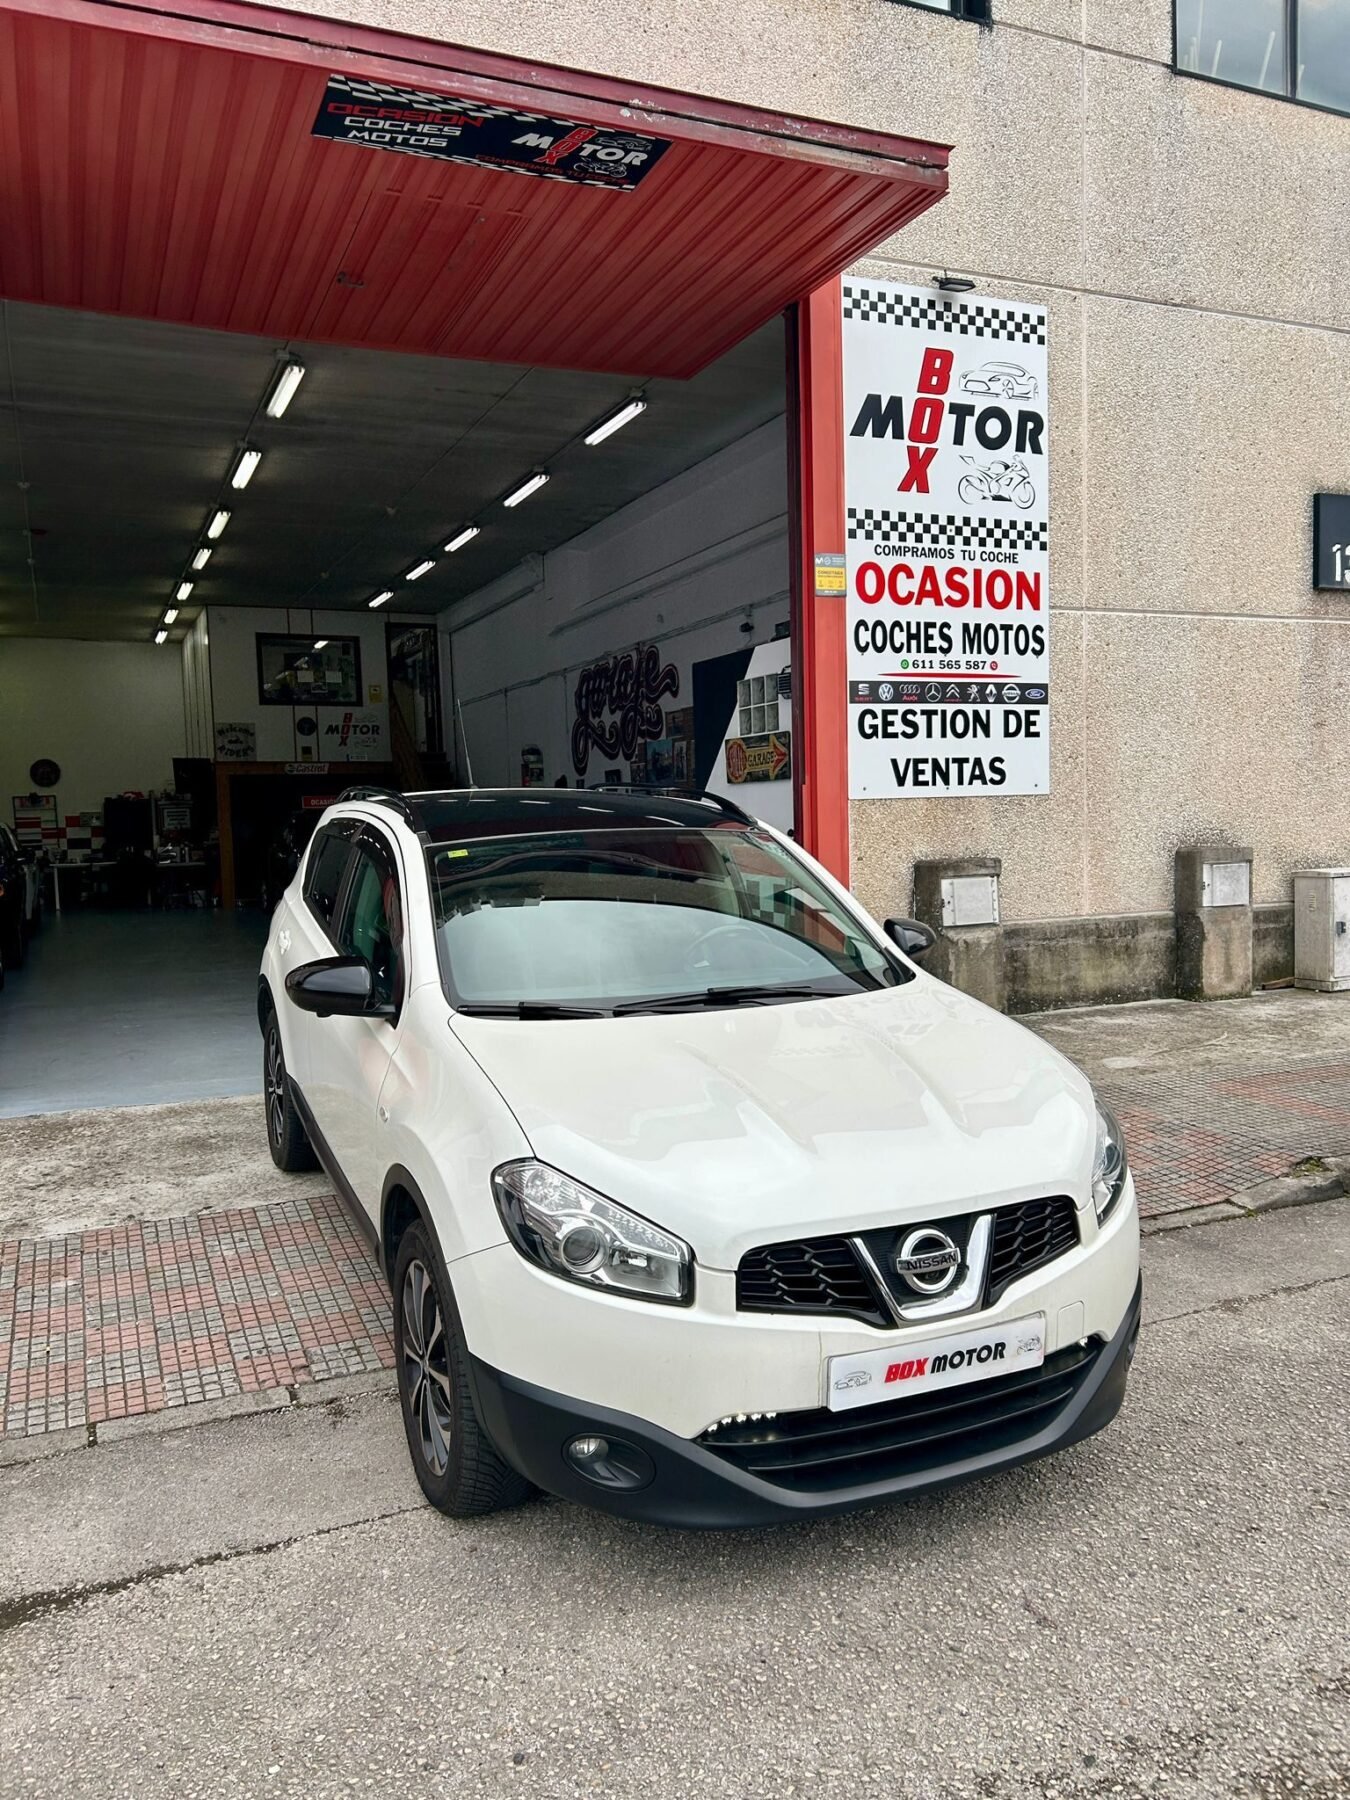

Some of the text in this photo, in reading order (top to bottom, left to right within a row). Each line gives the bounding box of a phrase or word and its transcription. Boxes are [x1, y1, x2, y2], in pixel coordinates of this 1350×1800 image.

[327, 102, 485, 127] OCASION
[344, 116, 462, 136] COCHES
[347, 130, 449, 147] MOTOS
[511, 133, 648, 165] MOTOR
[849, 393, 1044, 455] MOTOR
[897, 347, 954, 494] BOX
[874, 544, 1019, 564] COMPRAMOS TU COCHE
[855, 561, 1041, 611] OCASION
[854, 619, 1045, 657] COCHES MOTOS
[912, 659, 987, 670] 611 565 587
[326, 724, 380, 735] MOTOR
[857, 708, 1041, 740] GESTION DE
[296, 763, 326, 773] Castrol
[748, 751, 774, 767] GARAGE
[890, 756, 1007, 787] VENTAS
[906, 1253, 957, 1270] NISSAN
[884, 1341, 1007, 1383] BOX MOTOR
